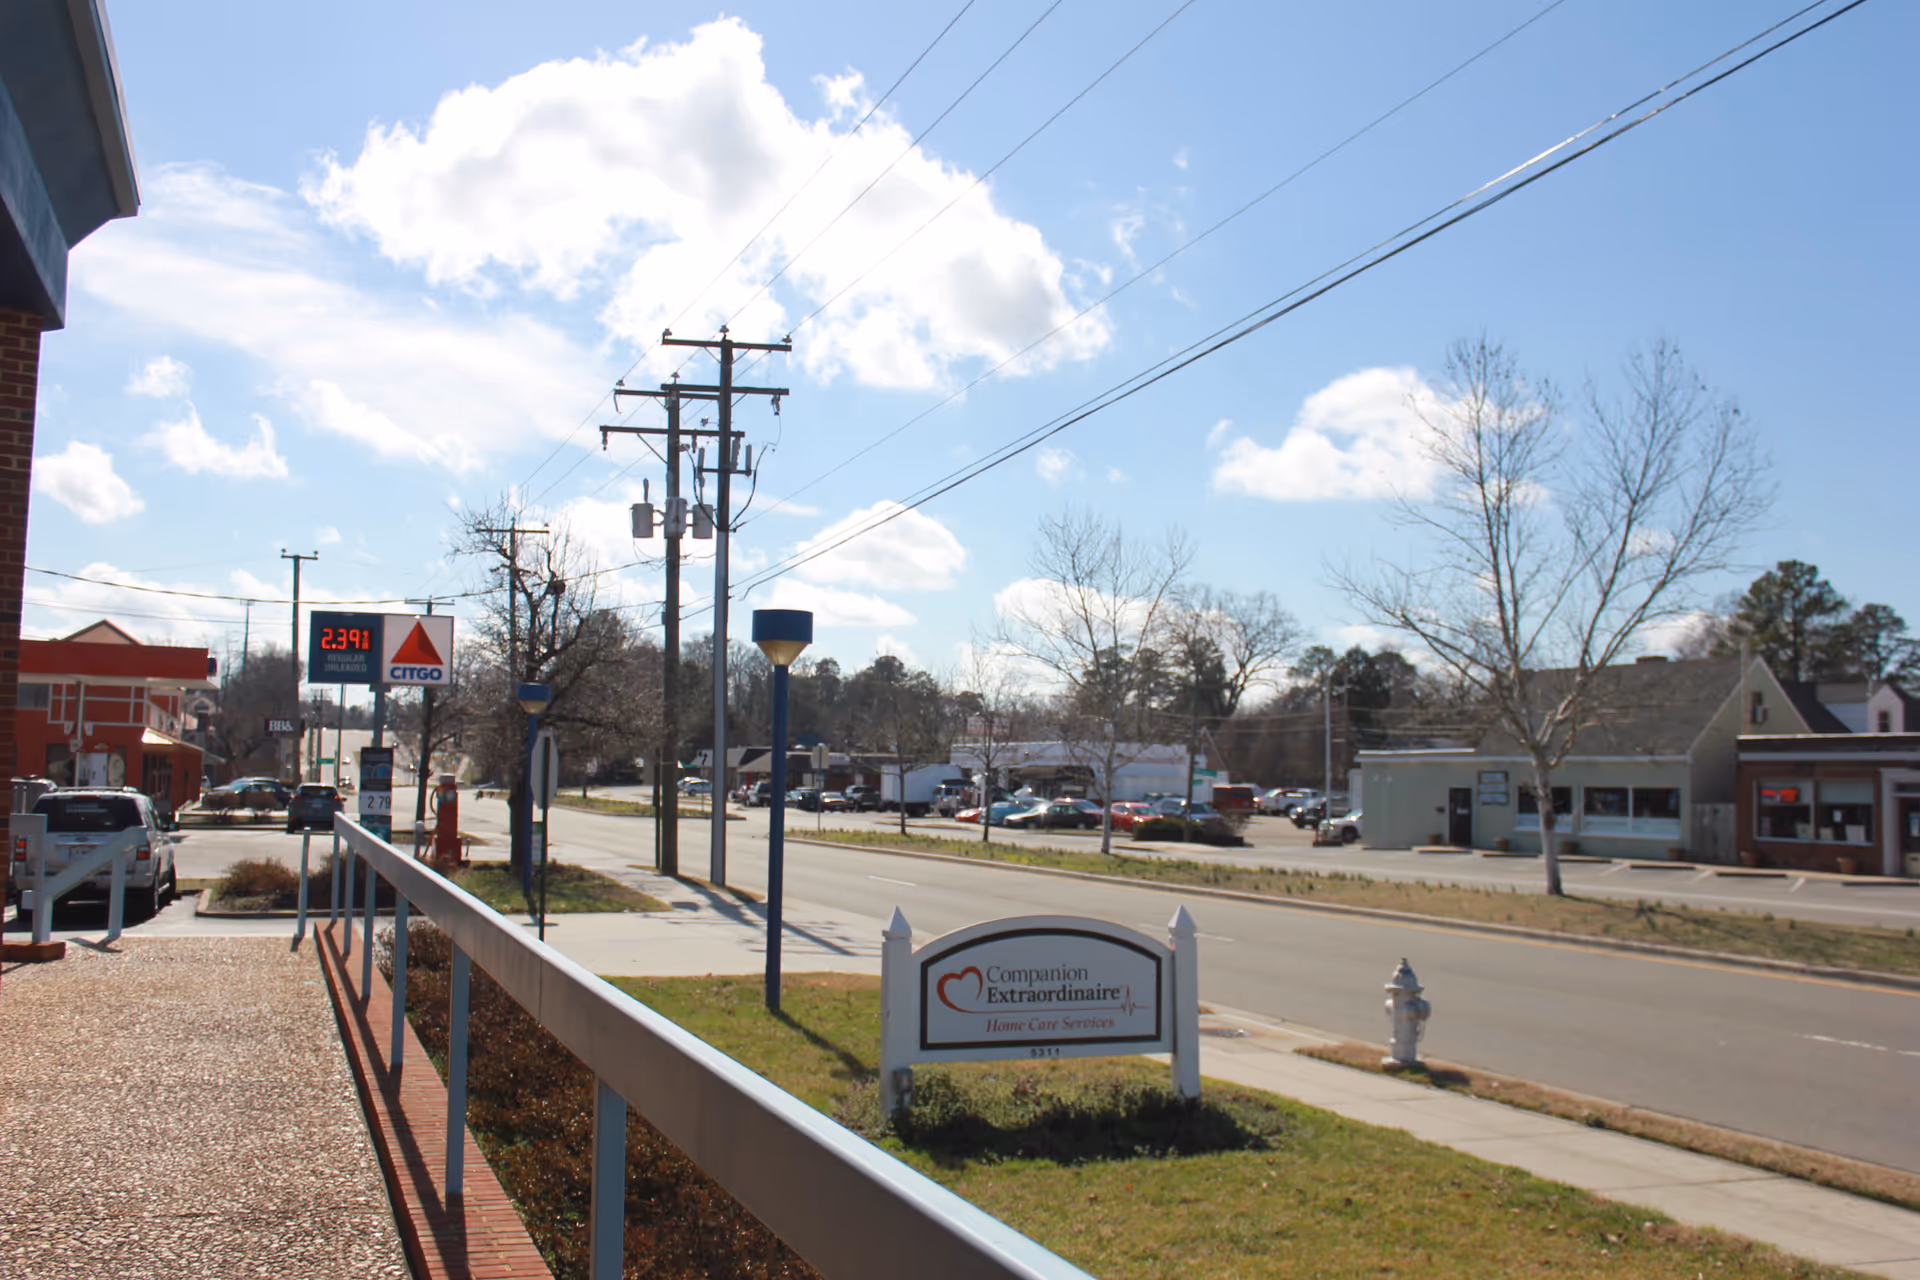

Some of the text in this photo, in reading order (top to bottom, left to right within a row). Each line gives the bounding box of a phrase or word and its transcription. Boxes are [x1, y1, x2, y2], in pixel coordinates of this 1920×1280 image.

[390, 667, 442, 680] CITGO
[269, 720, 293, 731] BB&
[986, 964, 1088, 987] Companion
[986, 982, 1121, 1004] Extraordinaire
[986, 1016, 1115, 1032] Home Care Services
